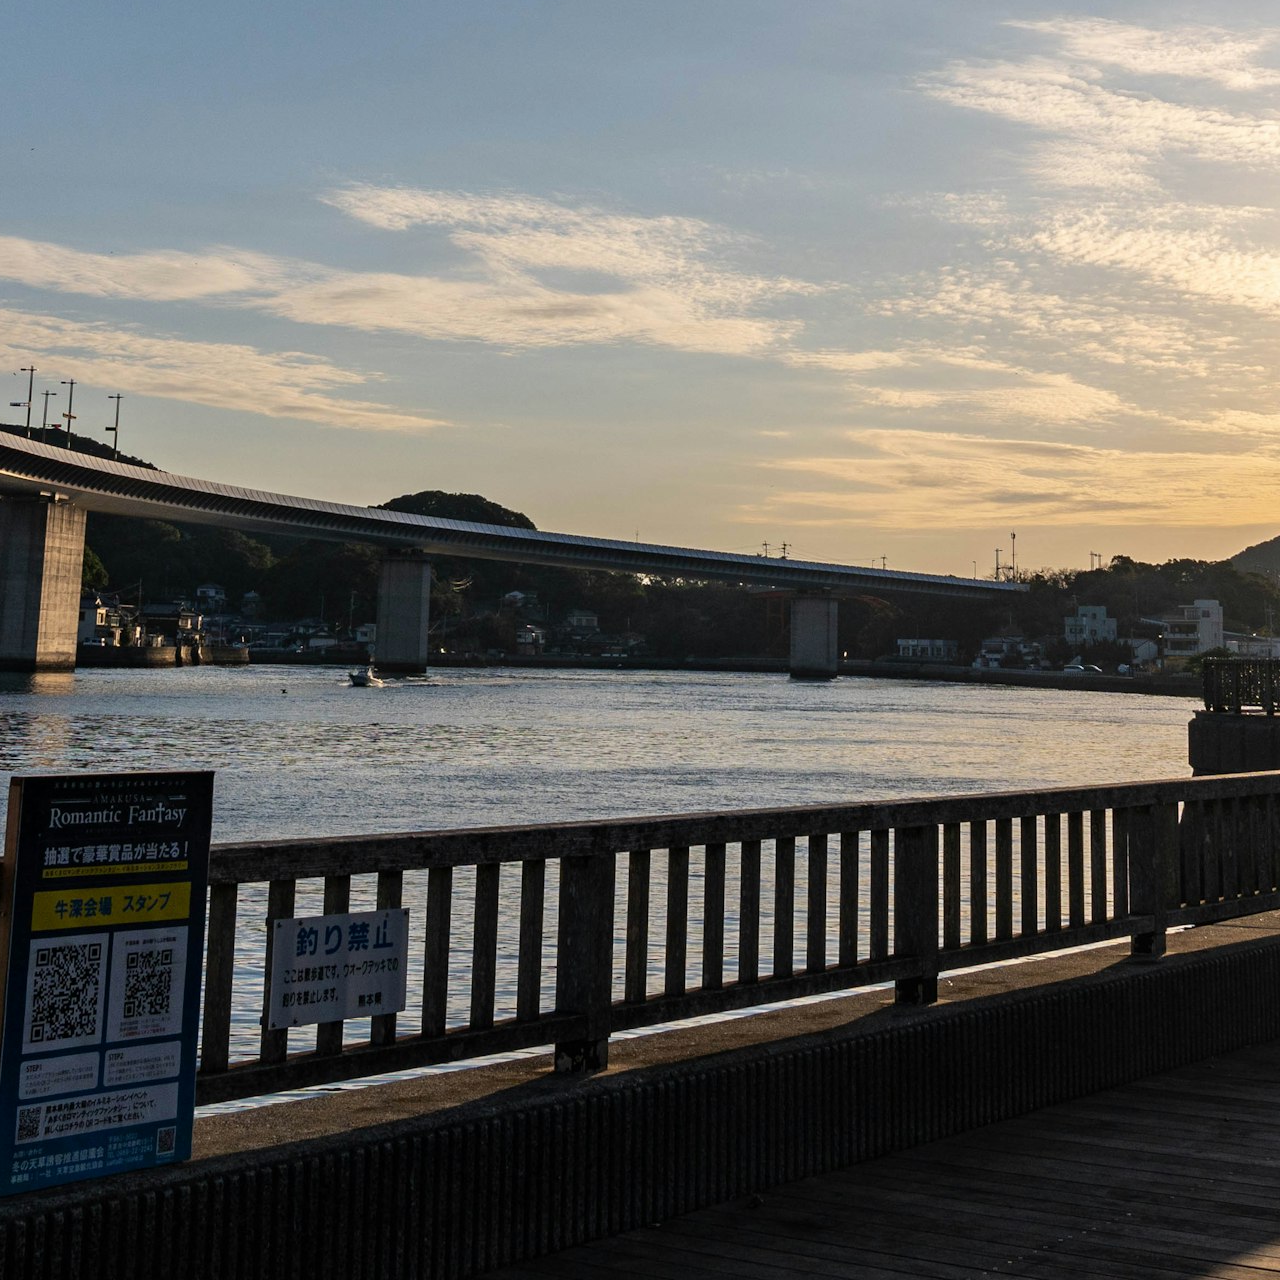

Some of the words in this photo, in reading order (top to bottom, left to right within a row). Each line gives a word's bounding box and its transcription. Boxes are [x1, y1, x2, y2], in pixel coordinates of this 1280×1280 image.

[93, 792, 145, 803] AMAKUSA
[48, 804, 122, 829] Romantic
[127, 801, 188, 828] Fantasy
[54, 896, 113, 920] 牛深会場
[123, 891, 172, 912] スタンプ
[296, 919, 395, 957] 釣り禁止
[282, 987, 339, 1008] 釣りを禁止します。
[358, 991, 383, 1007] 熊本県
[108, 1052, 123, 1061] STEP2
[26, 1064, 42, 1073] STEP1
